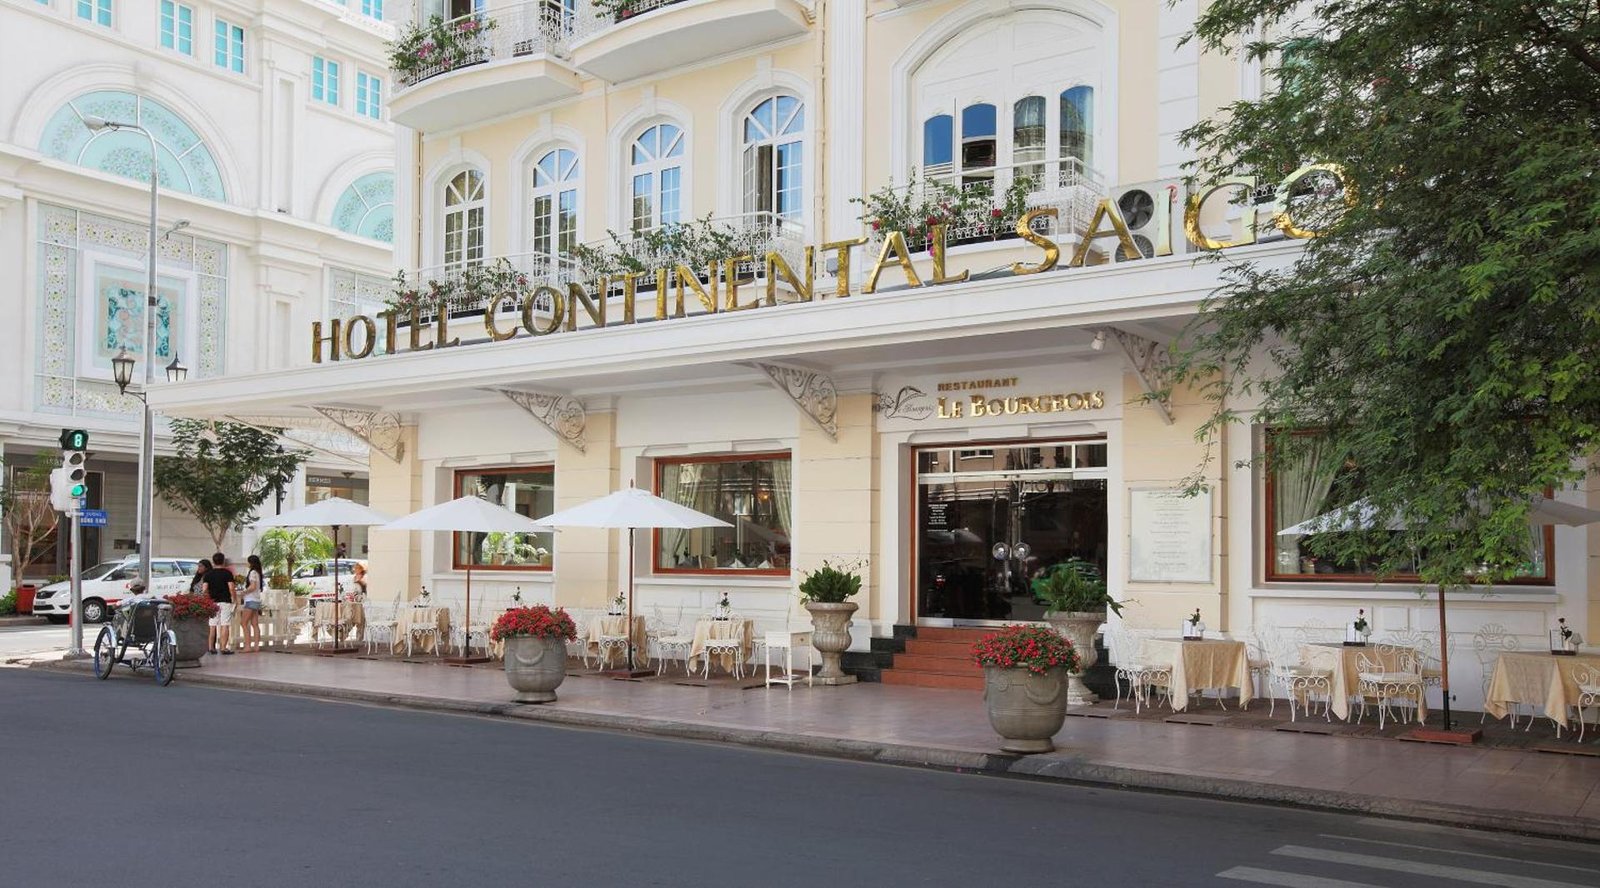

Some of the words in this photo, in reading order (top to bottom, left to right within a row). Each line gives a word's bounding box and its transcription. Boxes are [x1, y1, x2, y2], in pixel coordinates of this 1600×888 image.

[311, 303, 460, 363] HOTEL
[485, 223, 971, 342] CONTINENTAL
[1009, 162, 1404, 275] SAIGO
[937, 377, 1018, 391] RESTAURANT
[74, 433, 83, 447] 8
